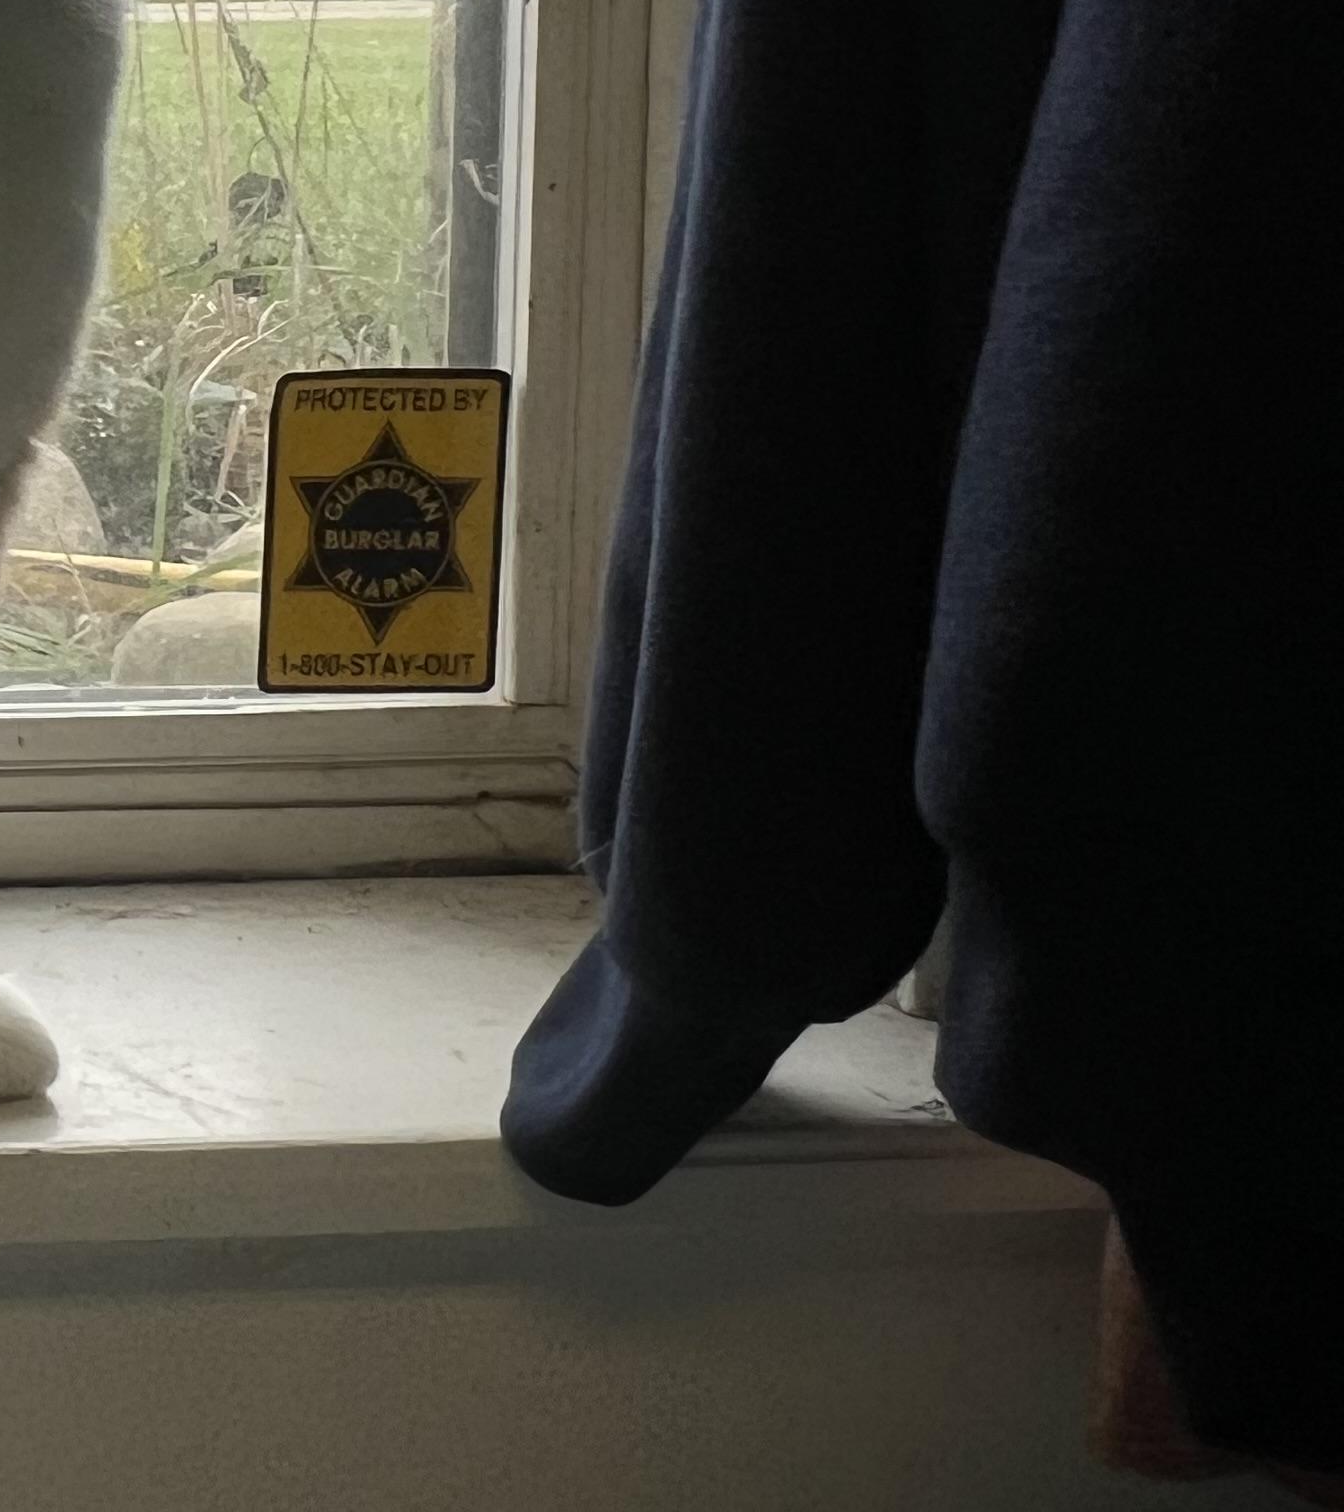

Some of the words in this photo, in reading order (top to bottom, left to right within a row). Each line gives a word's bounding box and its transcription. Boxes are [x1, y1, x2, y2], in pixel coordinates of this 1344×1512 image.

[294, 387, 446, 411] PROTECTED
[454, 388, 489, 411] BY
[324, 468, 445, 523] GUARDIAN
[323, 529, 441, 551] BURGLAR
[334, 567, 429, 600] ALARM
[279, 652, 475, 677] 1-800-STAY-OUT
